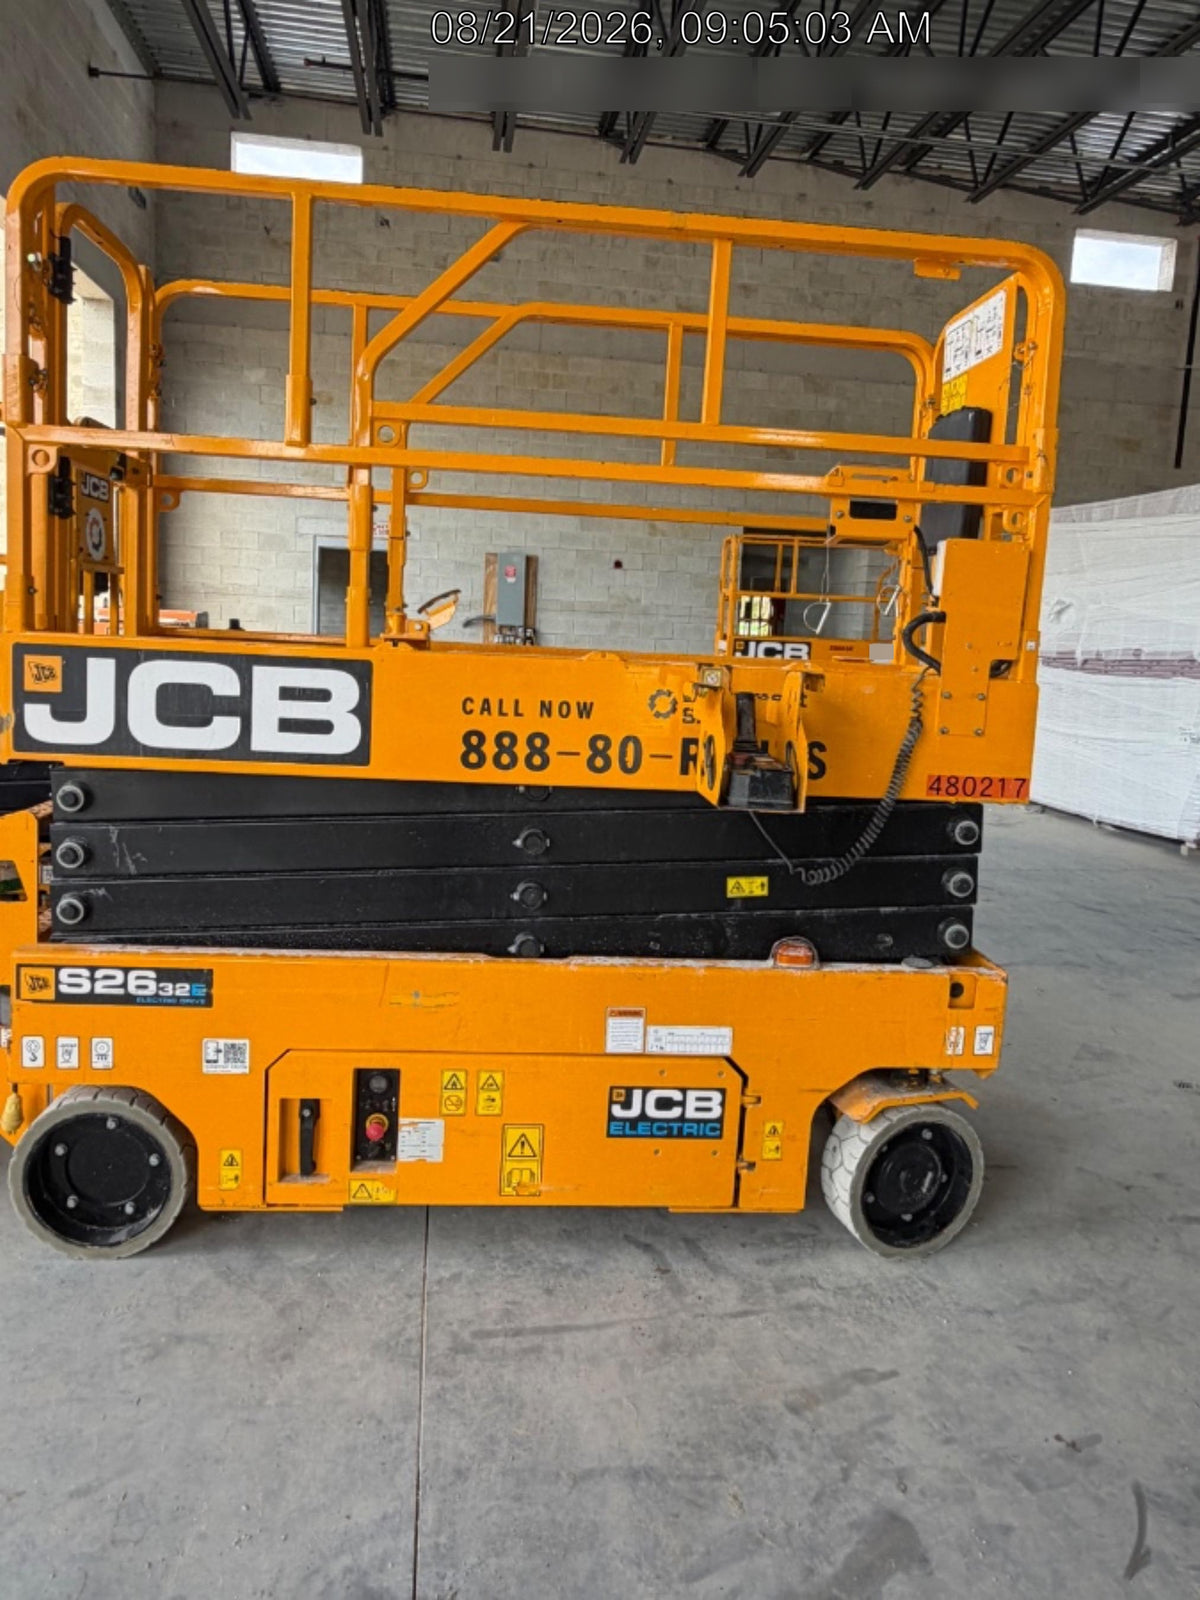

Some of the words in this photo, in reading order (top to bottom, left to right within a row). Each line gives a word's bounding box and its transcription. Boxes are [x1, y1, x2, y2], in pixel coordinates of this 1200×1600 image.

[81, 473, 110, 501] JCB
[735, 641, 810, 661] JCB
[24, 657, 362, 755] JCB
[461, 697, 525, 718] CALL
[539, 700, 594, 719] NOW
[928, 774, 1028, 798] 480217
[611, 1089, 723, 1119] JCB
[609, 1121, 721, 1137] ELECTRIC
